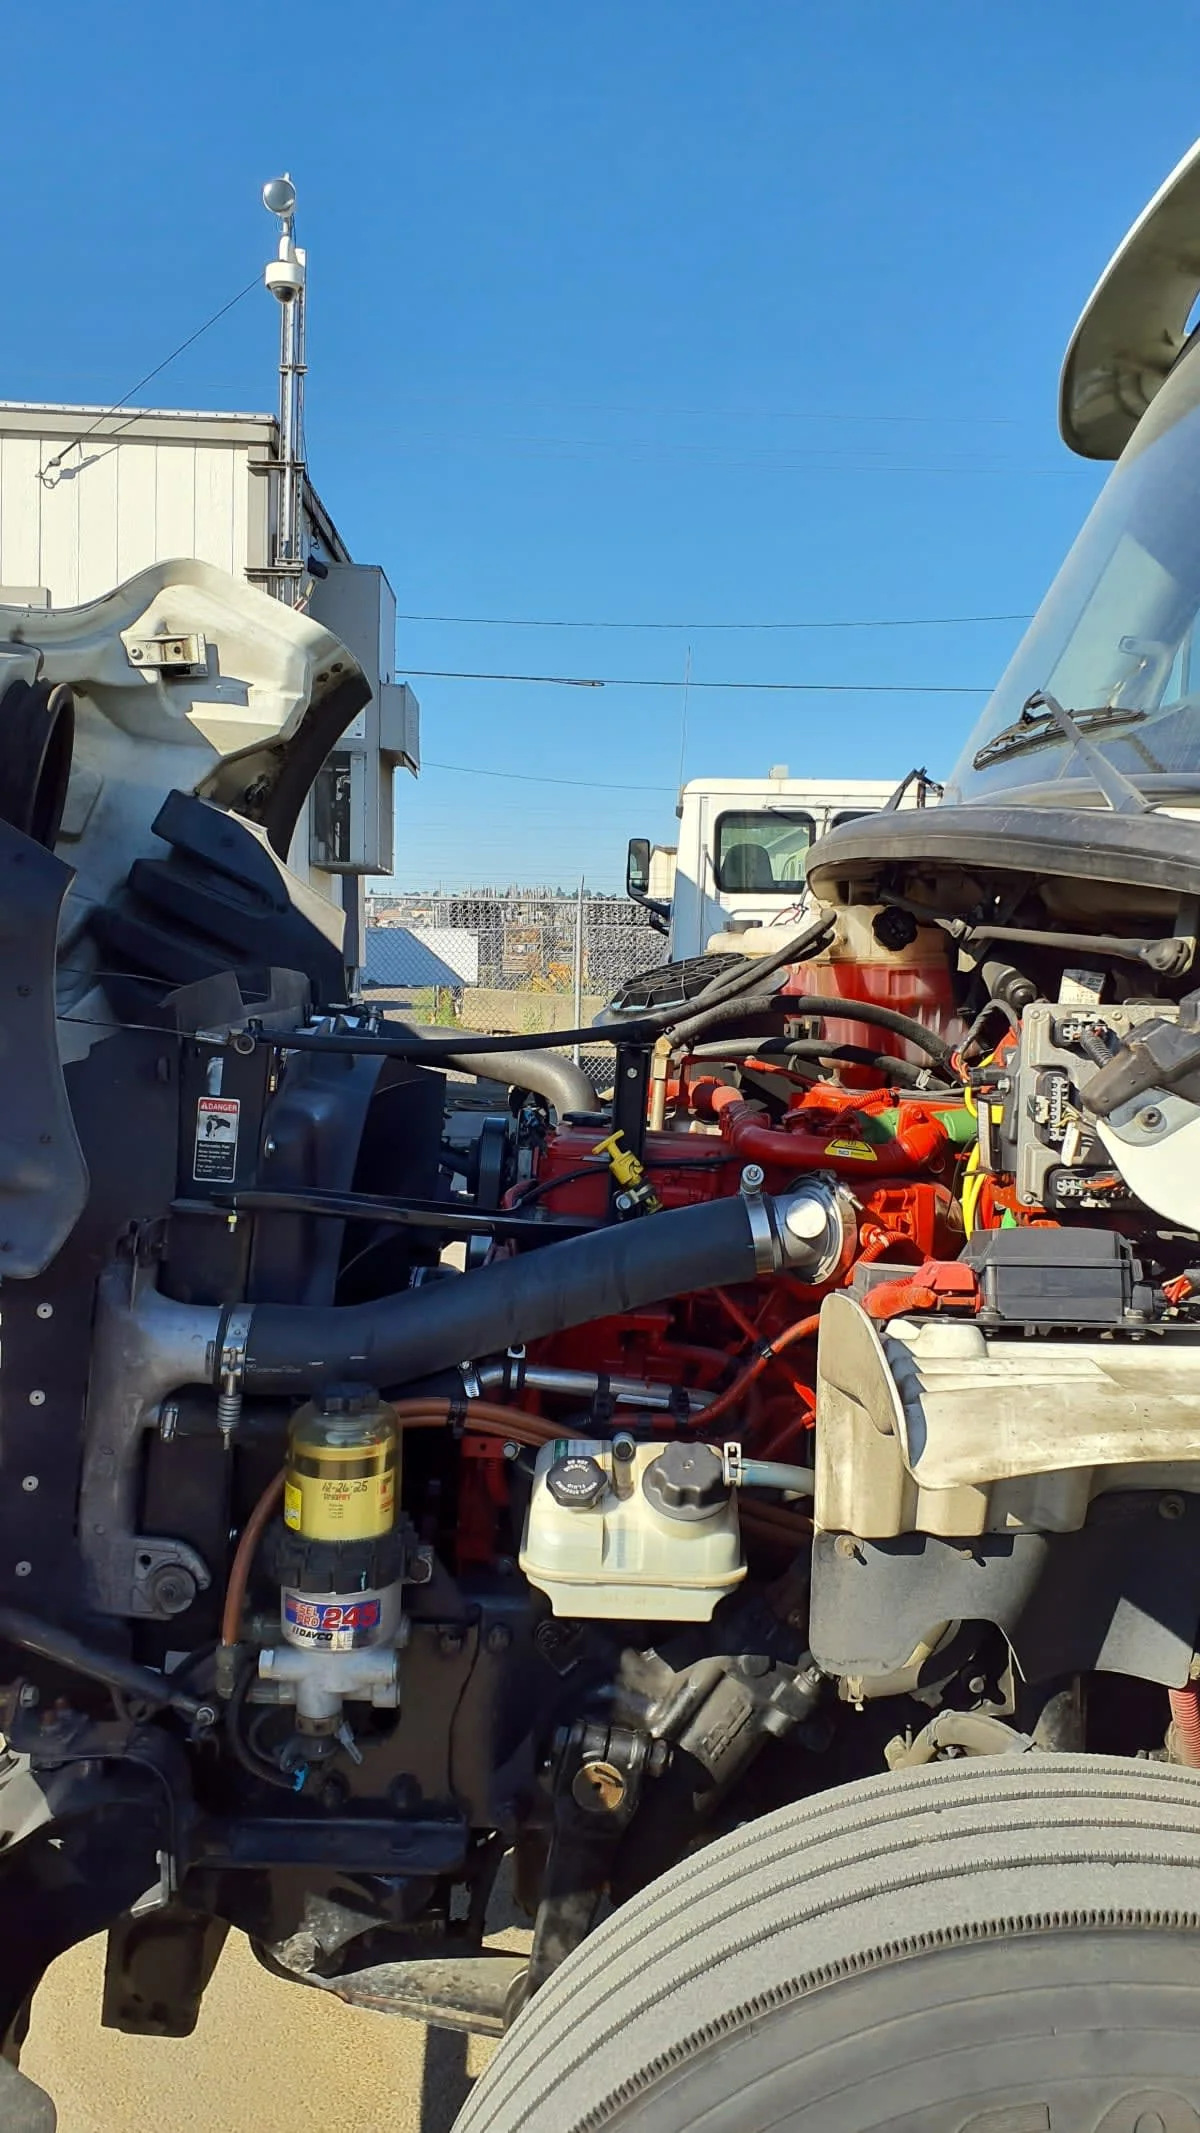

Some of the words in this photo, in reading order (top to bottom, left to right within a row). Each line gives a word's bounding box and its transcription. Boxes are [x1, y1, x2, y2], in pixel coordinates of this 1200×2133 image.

[208, 1103, 238, 1111] DANGER
[296, 1614, 320, 1627] PRO
[321, 1602, 377, 1631] 245
[300, 1628, 333, 1641] DAVCO
